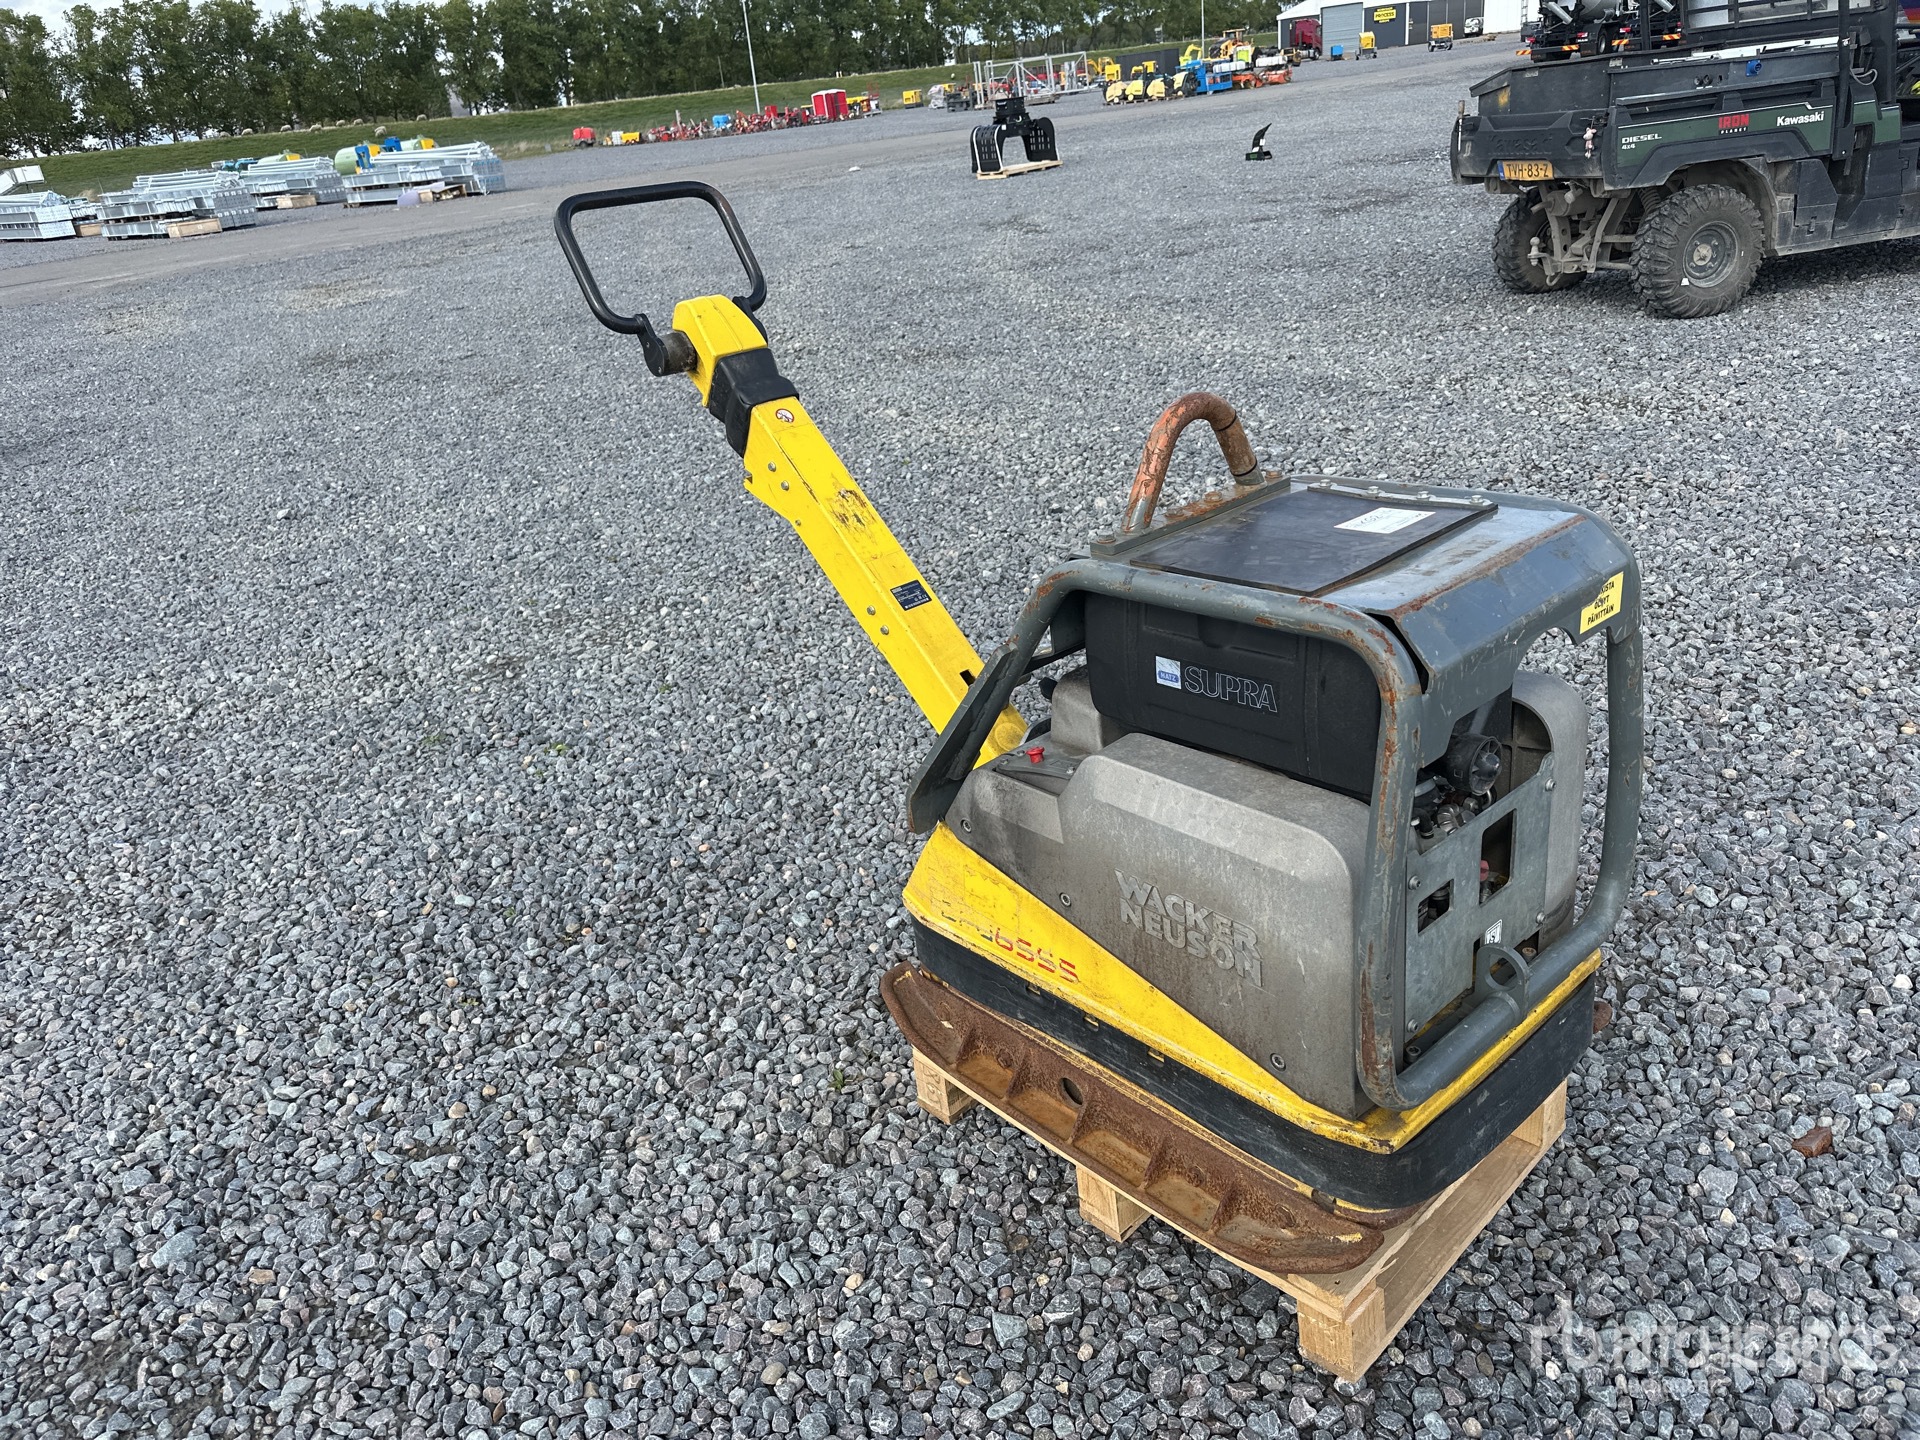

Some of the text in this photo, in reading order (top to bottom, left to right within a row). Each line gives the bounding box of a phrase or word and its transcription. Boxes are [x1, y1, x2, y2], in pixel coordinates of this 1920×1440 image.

[1718, 113, 1750, 129] IRON
[1776, 111, 1825, 127] Kawasaki
[1621, 133, 1662, 144] DIESEL
[1184, 665, 1278, 713] SUPRA
[1114, 868, 1264, 961] WACKER
[1119, 897, 1263, 988] NEUSON
